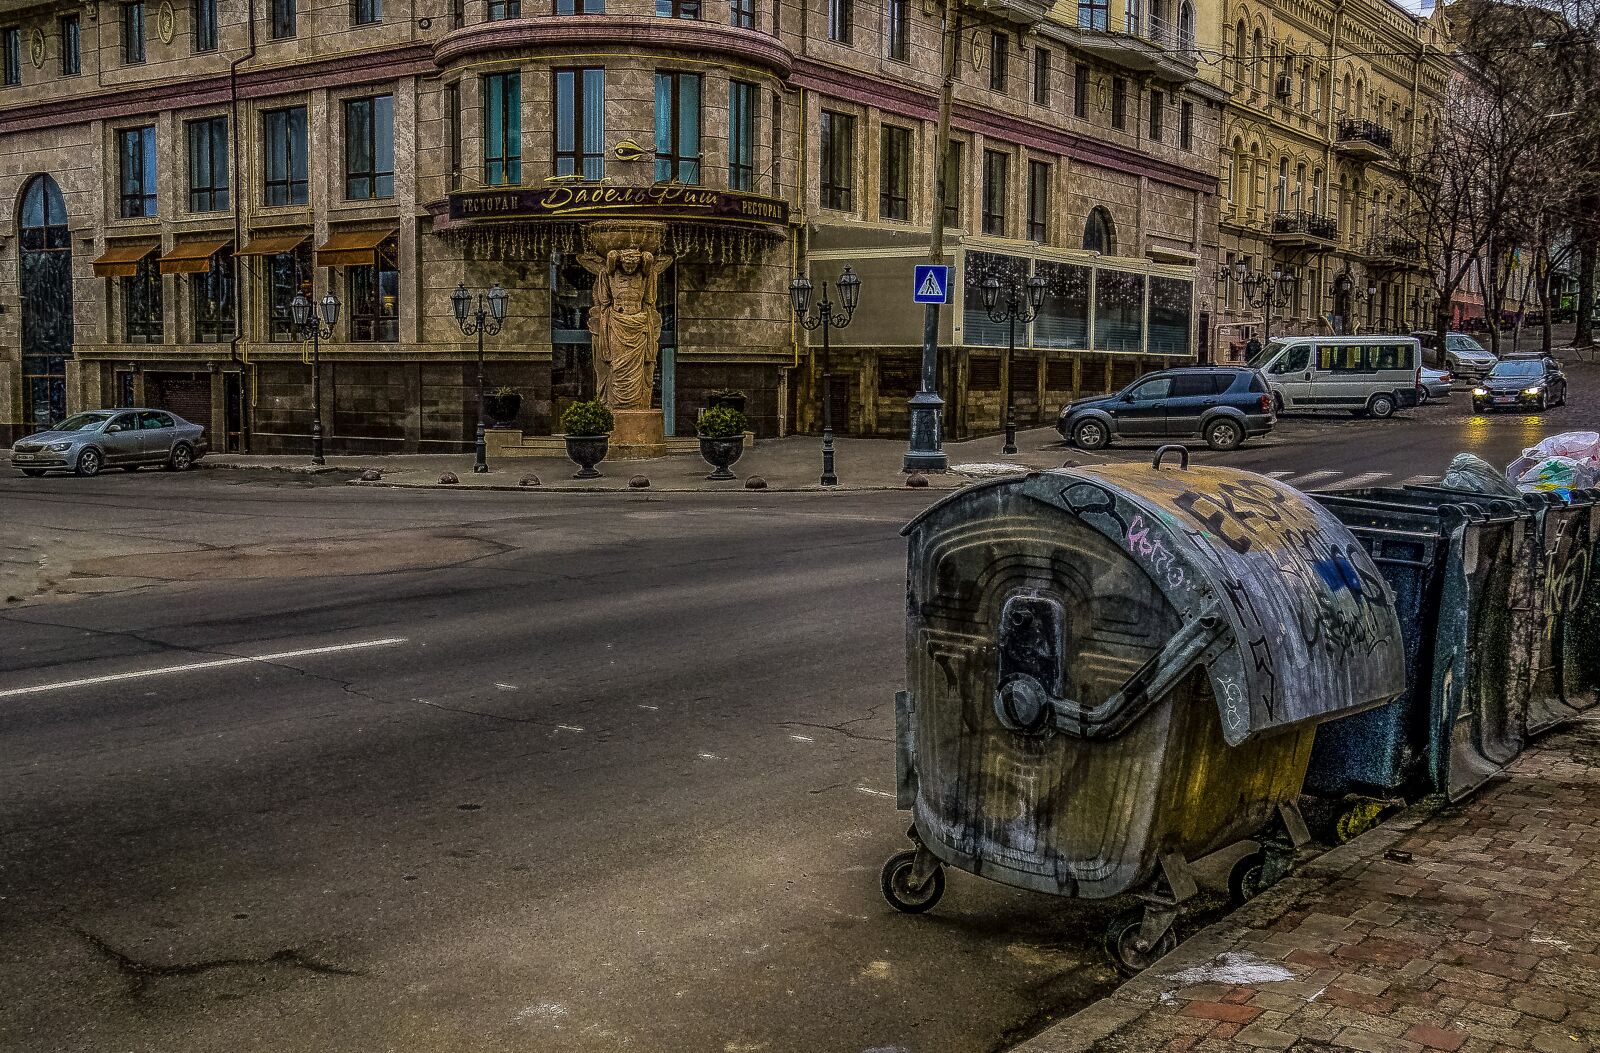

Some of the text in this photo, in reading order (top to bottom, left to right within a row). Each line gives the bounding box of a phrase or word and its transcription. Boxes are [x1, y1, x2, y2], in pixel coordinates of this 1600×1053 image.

[540, 175, 717, 208] Бабель Фиш
[463, 196, 518, 212] РЕСТОРАН
[742, 200, 782, 219] РЕСТОРАН
